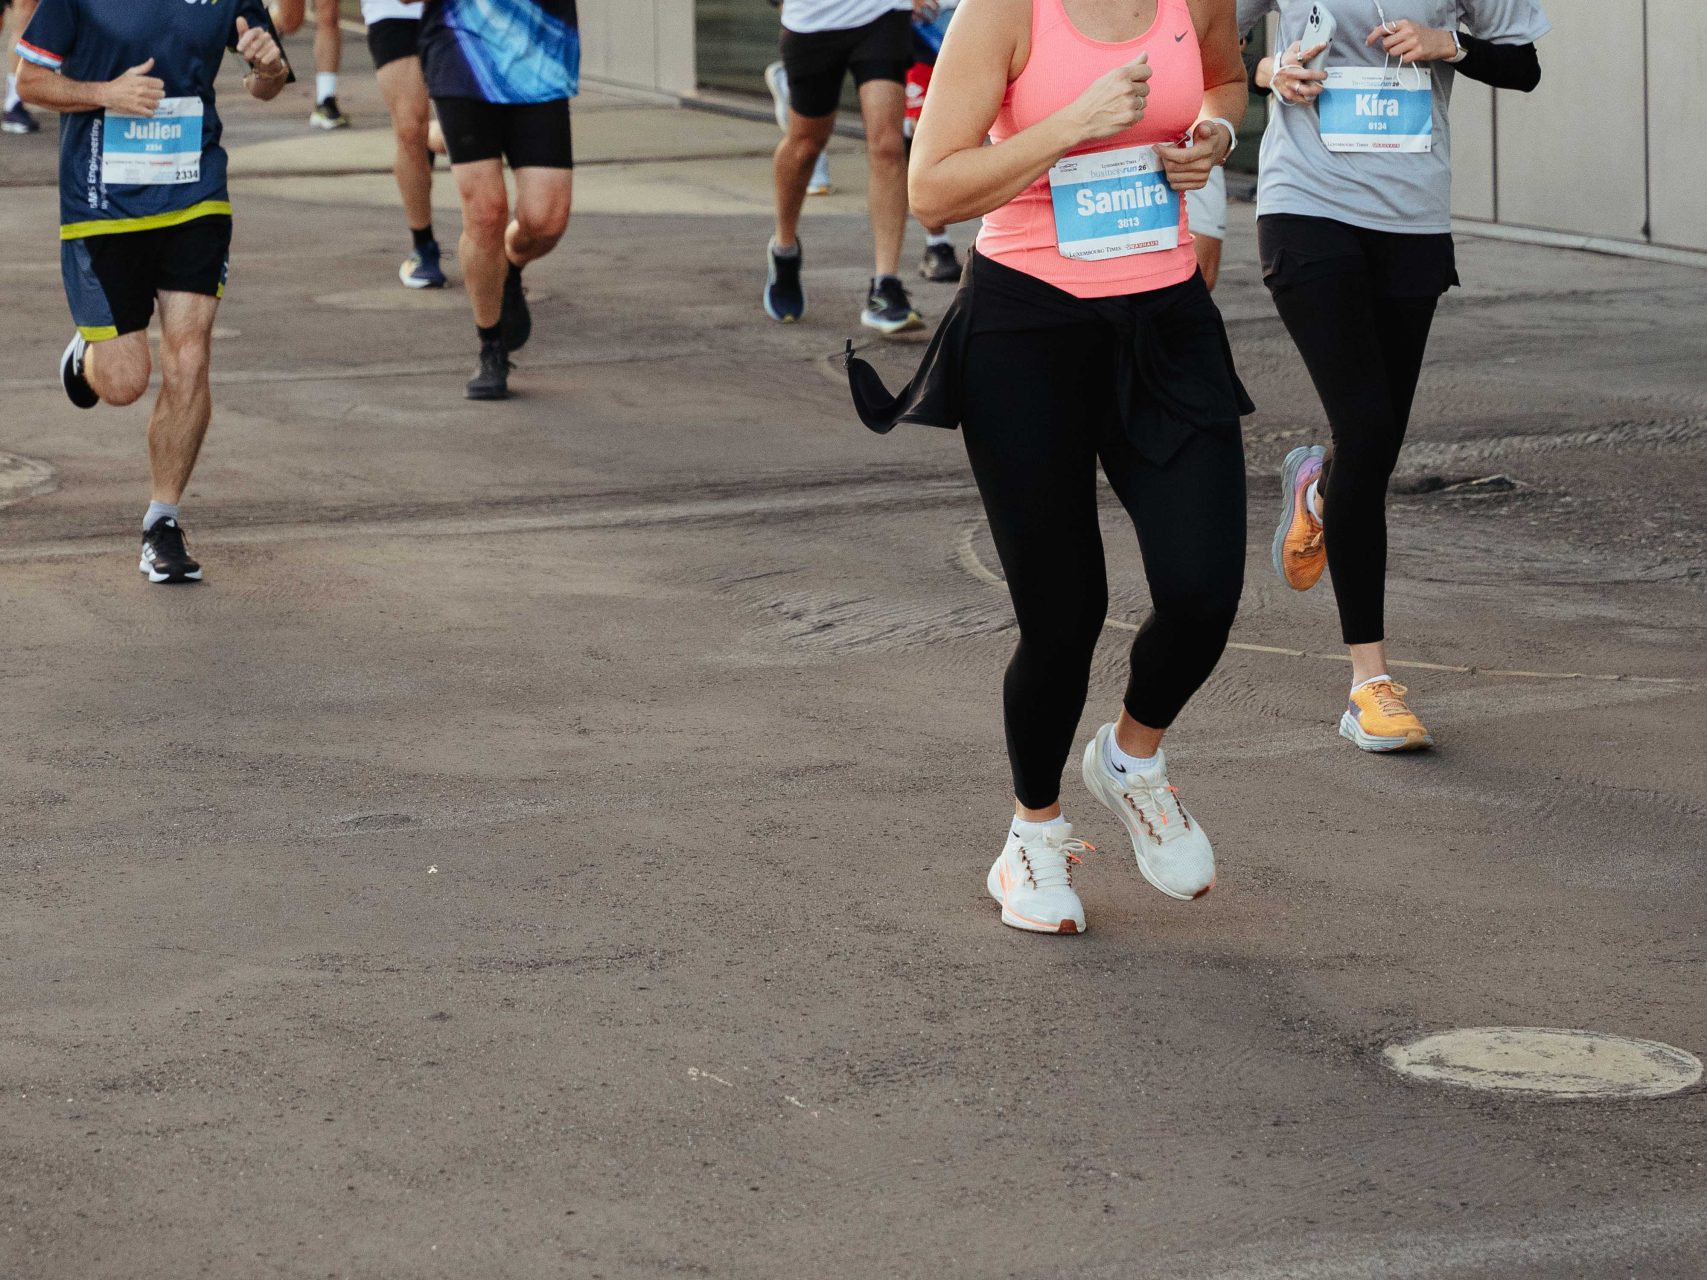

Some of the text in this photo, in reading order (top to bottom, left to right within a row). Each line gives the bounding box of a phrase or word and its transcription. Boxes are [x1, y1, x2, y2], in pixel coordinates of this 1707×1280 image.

[1355, 93, 1399, 117] Kira
[124, 121, 182, 140] Julien
[175, 170, 199, 181] 2334
[1138, 164, 1147, 172] 26
[1076, 181, 1168, 217] Samira
